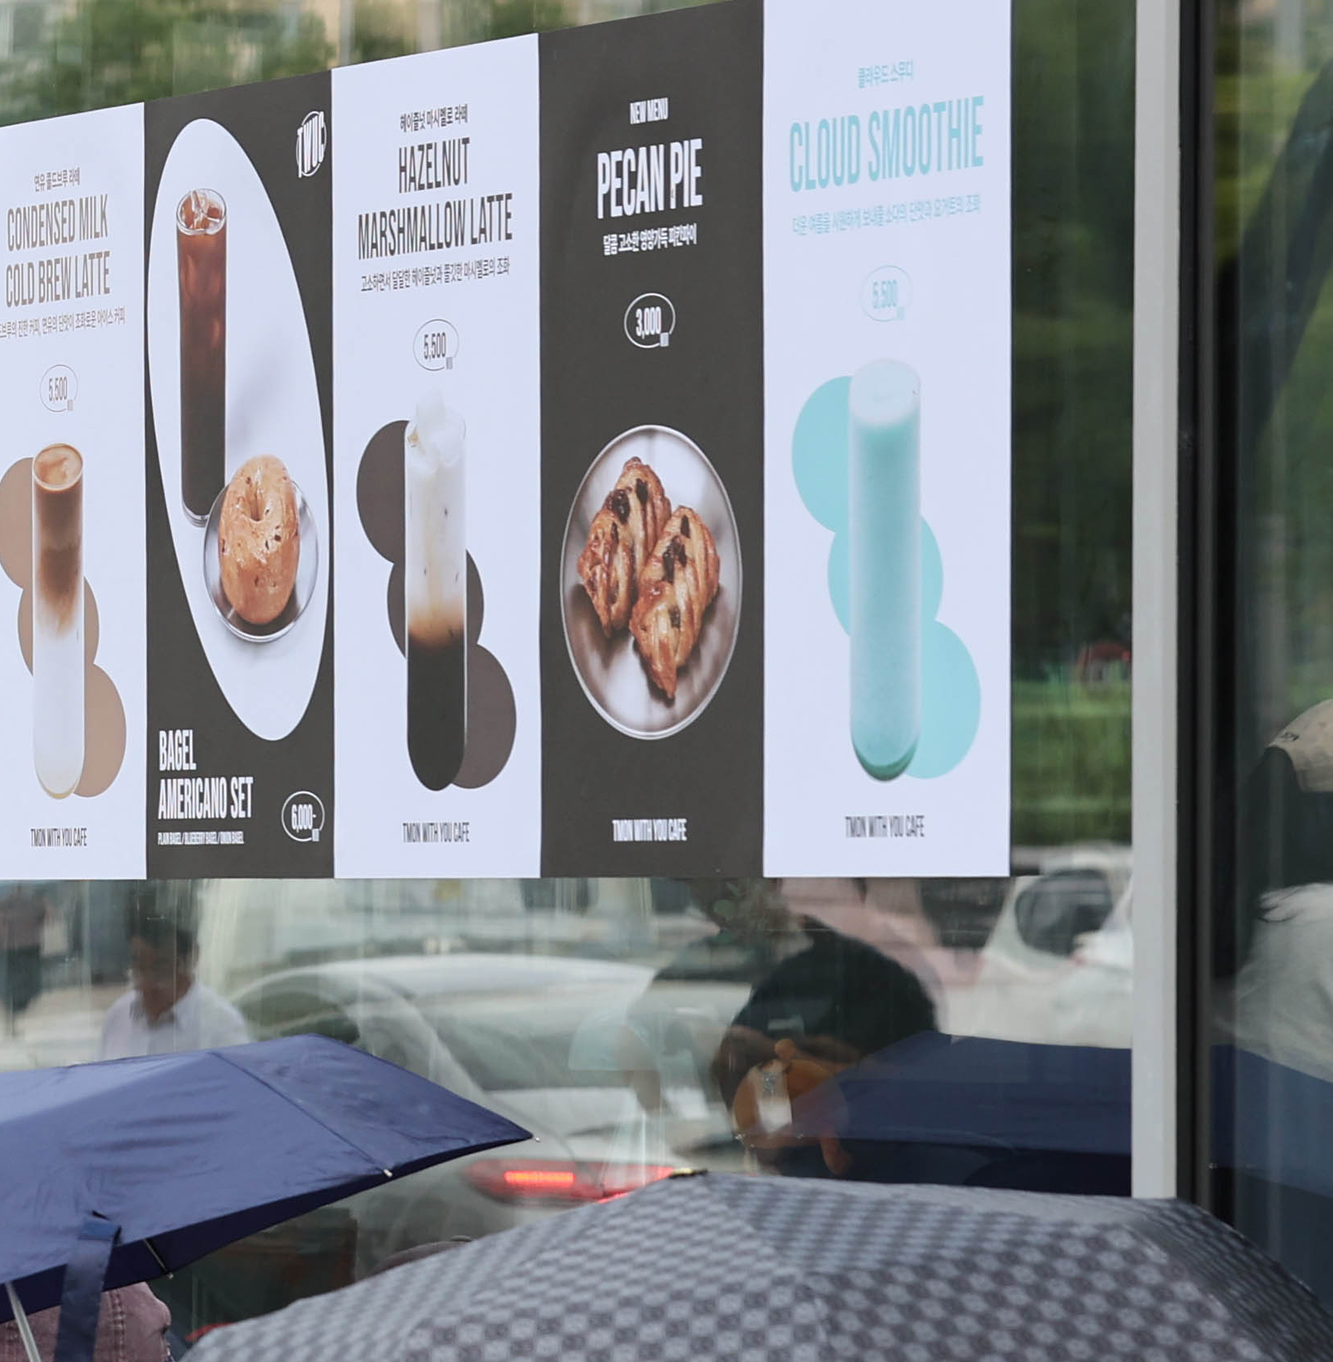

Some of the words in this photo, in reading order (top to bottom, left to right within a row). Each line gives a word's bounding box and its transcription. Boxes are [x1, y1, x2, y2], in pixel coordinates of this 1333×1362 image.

[858, 65, 889, 89] 클라우드
[890, 59, 913, 83] 스무디
[400, 111, 425, 132] 헤이즐넛
[427, 107, 453, 128] 마시멜로
[455, 103, 468, 124] 라떼
[630, 101, 646, 125] NEW
[647, 97, 669, 122] MENU
[789, 114, 861, 193] CLOUD
[867, 95, 984, 182] SMOOTHIE
[34, 173, 45, 192] 연유
[46, 169, 67, 190] 콜드브루
[69, 167, 80, 186] 라떼
[398, 137, 470, 194] HAZELNUT
[597, 144, 665, 219] PECAN
[669, 138, 703, 210] PIE
[7, 199, 76, 251] CONDENSED
[79, 193, 108, 241] MILK
[358, 199, 466, 260] MARSHMALLOW
[470, 193, 513, 245] LATTE
[603, 234, 618, 256] 달콤
[618, 230, 640, 252] 고소한
[6, 262, 35, 308] COLD
[38, 256, 72, 303] BREW
[75, 250, 110, 298] LATTE
[361, 271, 392, 292] 고소하면서
[392, 268, 411, 290] 달달한
[412, 264, 443, 287] 헤이즐넛과
[464, 257, 496, 281] 마시멜로의
[497, 256, 510, 275] 조화
[114, 305, 125, 325] 커피
[636, 306, 662, 339] 3,000
[424, 332, 446, 361] 5,500
[159, 729, 196, 771] BAGEL
[158, 777, 227, 820] AMERICANO
[230, 776, 254, 819] SET
[30, 828, 46, 847] TMON
[47, 828, 60, 847] WITH
[61, 828, 72, 847] YOU
[73, 827, 87, 847] CAFE
[402, 822, 421, 843] TMON
[422, 822, 438, 843] WITH
[439, 822, 452, 843] YOU
[453, 822, 470, 843] CAFE
[612, 819, 633, 841] TMON
[634, 819, 653, 841] WITH
[653, 819, 668, 841] YOU
[668, 818, 687, 841] CAFE
[845, 816, 867, 838] TMON
[868, 816, 887, 838] WITH
[888, 816, 904, 837] YOU
[905, 815, 925, 837] CAFE
